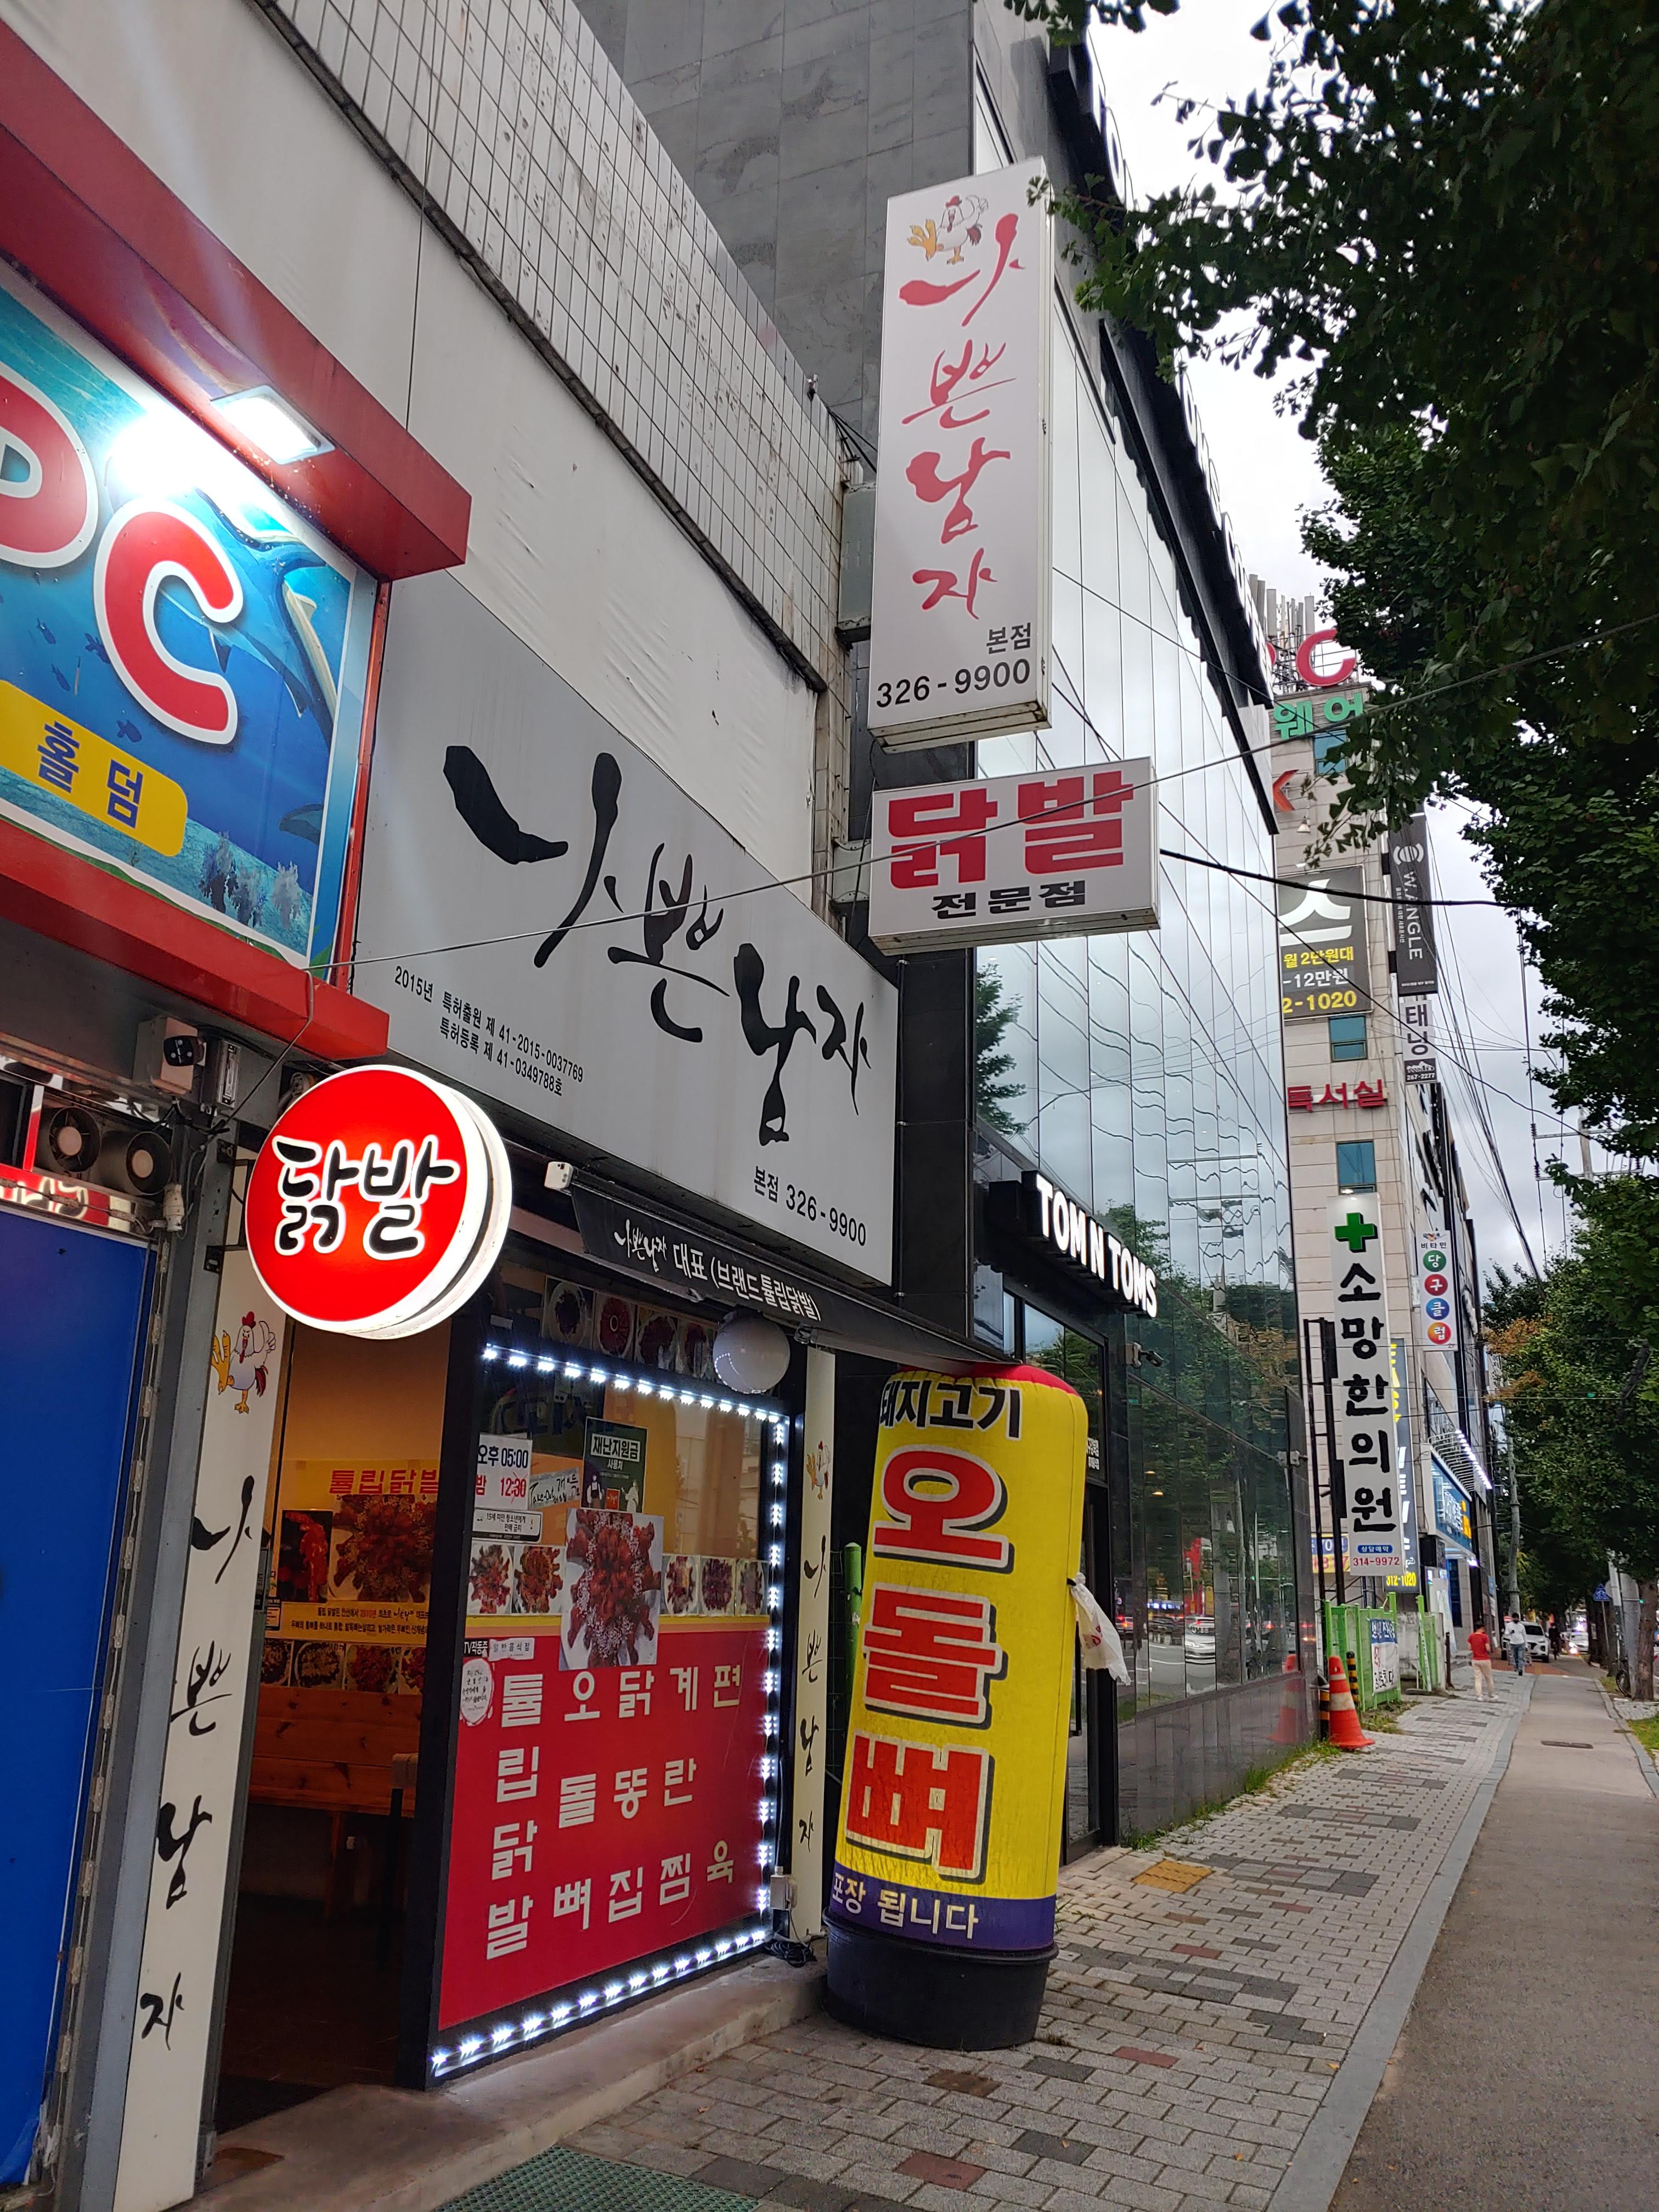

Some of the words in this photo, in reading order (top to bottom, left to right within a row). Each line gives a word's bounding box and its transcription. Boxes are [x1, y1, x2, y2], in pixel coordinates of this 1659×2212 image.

[986, 622, 1031, 654] 본점
[877, 658, 1031, 708] 326-9900
[37, 720, 144, 829] 홀덤
[888, 770, 1133, 889] 닭발
[931, 881, 1086, 919] 전문점
[1284, 953, 1298, 968] 월
[1300, 946, 1354, 965] 2만원대
[394, 966, 433, 1003] 2015년
[442, 991, 482, 1029] 특허출원
[486, 1017, 495, 1037] 제
[499, 1024, 583, 1082] 41-2015-0037769
[440, 1017, 479, 1054] 특허등록
[484, 1041, 493, 1062] 제
[496, 1049, 562, 1096] 41-0349788호
[1405, 1004, 1428, 1055] 태닝
[1287, 1079, 1386, 1113] 독서실
[273, 1136, 459, 1260] 닭발
[753, 1165, 778, 1203] 본점
[786, 1184, 866, 1246] 326-9900
[673, 1243, 708, 1280] 대표
[710, 1256, 821, 1321] (브랜드튤립닭발)
[1036, 1173, 1087, 1265] TOM
[1089, 1218, 1105, 1279] N
[1108, 1234, 1158, 1318] TOMS
[1427, 1254, 1446, 1340] 당구클럽
[1338, 1262, 1397, 1533] 소망한의원
[478, 1445, 499, 1466] 오후
[501, 1448, 528, 1468] 05:00
[593, 1436, 638, 1459] 재난지원금
[607, 1459, 623, 1470] 사용처
[506, 1515, 526, 1523] 청소년에게
[1353, 1557, 1400, 1566] 314-9972
[1386, 1572, 1417, 1587] 312-1020
[846, 1446, 1007, 1877] 오돌뼈
[487, 1674, 543, 1960] 튤립닭발
[554, 1672, 600, 1930] 오돌뼈
[608, 1671, 654, 1923] 닭똥집
[659, 1667, 699, 1905] 계란찜
[832, 1872, 866, 1915] 포장
[878, 1889, 978, 1939] 됩니다
